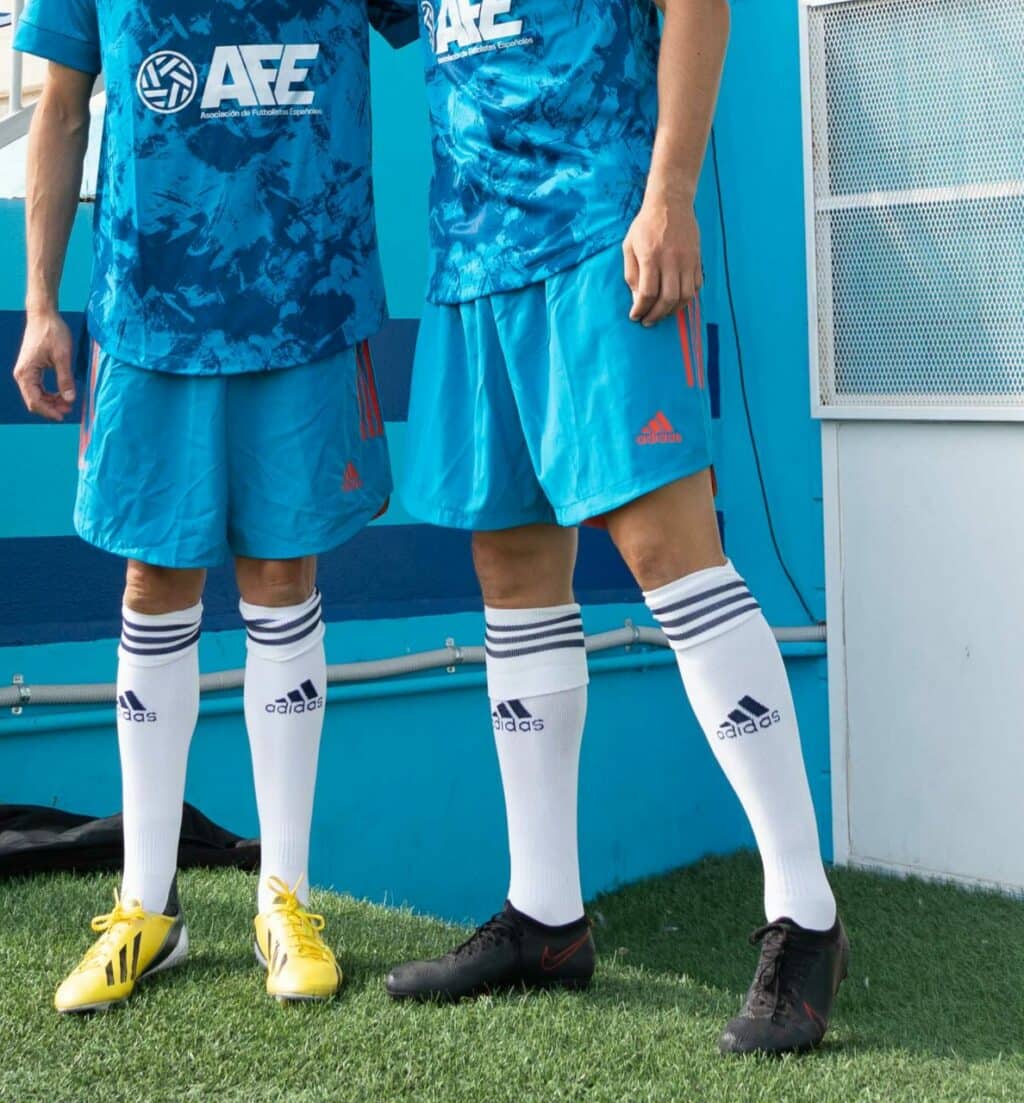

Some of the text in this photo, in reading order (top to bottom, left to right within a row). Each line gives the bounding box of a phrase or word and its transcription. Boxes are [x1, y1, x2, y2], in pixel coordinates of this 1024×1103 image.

[200, 44, 320, 109] AFE
[200, 109, 240, 120] Asociación
[264, 695, 324, 715] adidas
[122, 707, 158, 723] das
[494, 714, 545, 733] didas
[716, 708, 781, 741] adidas
